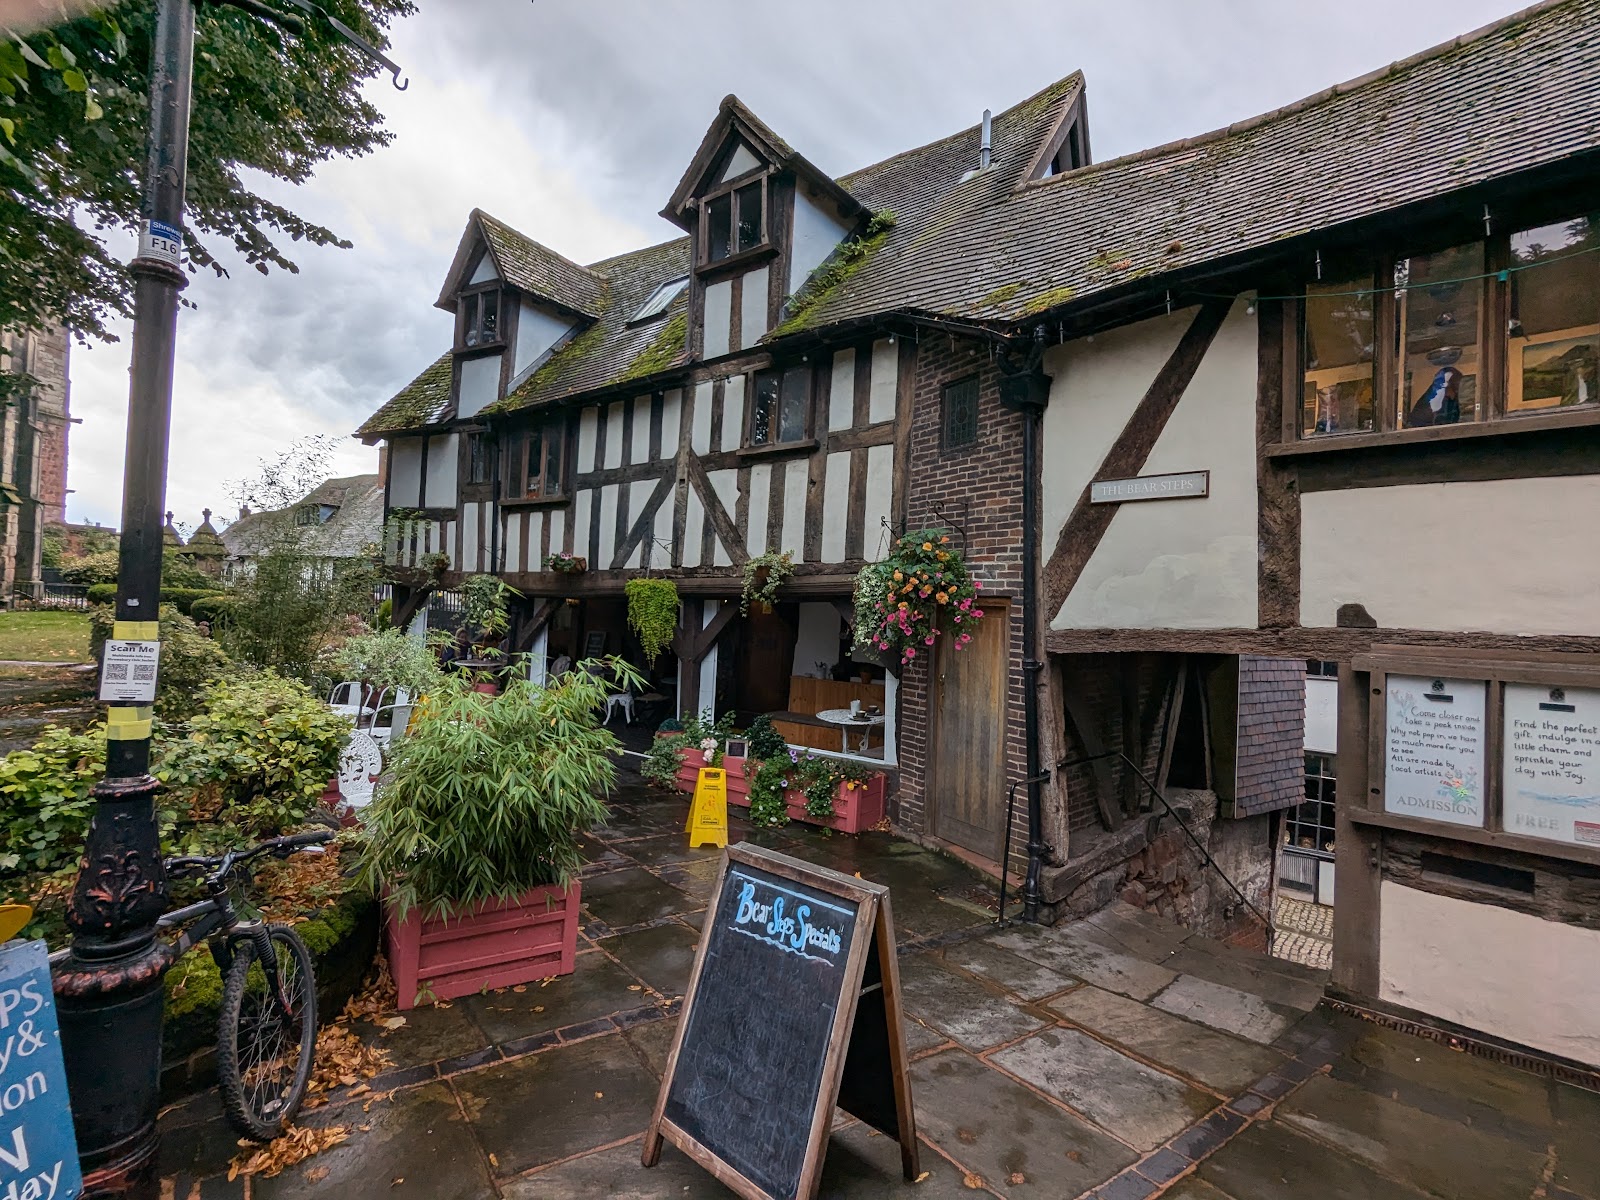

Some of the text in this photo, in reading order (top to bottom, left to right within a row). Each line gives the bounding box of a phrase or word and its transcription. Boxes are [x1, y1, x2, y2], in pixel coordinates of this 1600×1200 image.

[152, 238, 177, 255] F16
[1102, 479, 1193, 496] THE BEAR STEPS
[1411, 706, 1436, 717] Come
[1439, 710, 1463, 720] closer
[1405, 717, 1422, 725] take
[1433, 721, 1452, 730] peek
[1514, 720, 1598, 734] Find the perfect
[1390, 726, 1406, 737] Why
[1423, 732, 1435, 740] pop
[1460, 734, 1477, 743] have
[1514, 743, 1536, 751] little
[1574, 749, 1592, 757] and
[1391, 754, 1404, 762] All
[1421, 758, 1443, 767] made
[1446, 760, 1455, 770] by
[1514, 755, 1583, 770] sprinkle your
[1414, 768, 1442, 777] artists
[1515, 765, 1535, 778] day
[1541, 769, 1561, 777] with
[1396, 796, 1478, 816] ADMISSION
[1515, 813, 1560, 831] FREE
[736, 881, 773, 924] Bear
[767, 897, 796, 943] Steps
